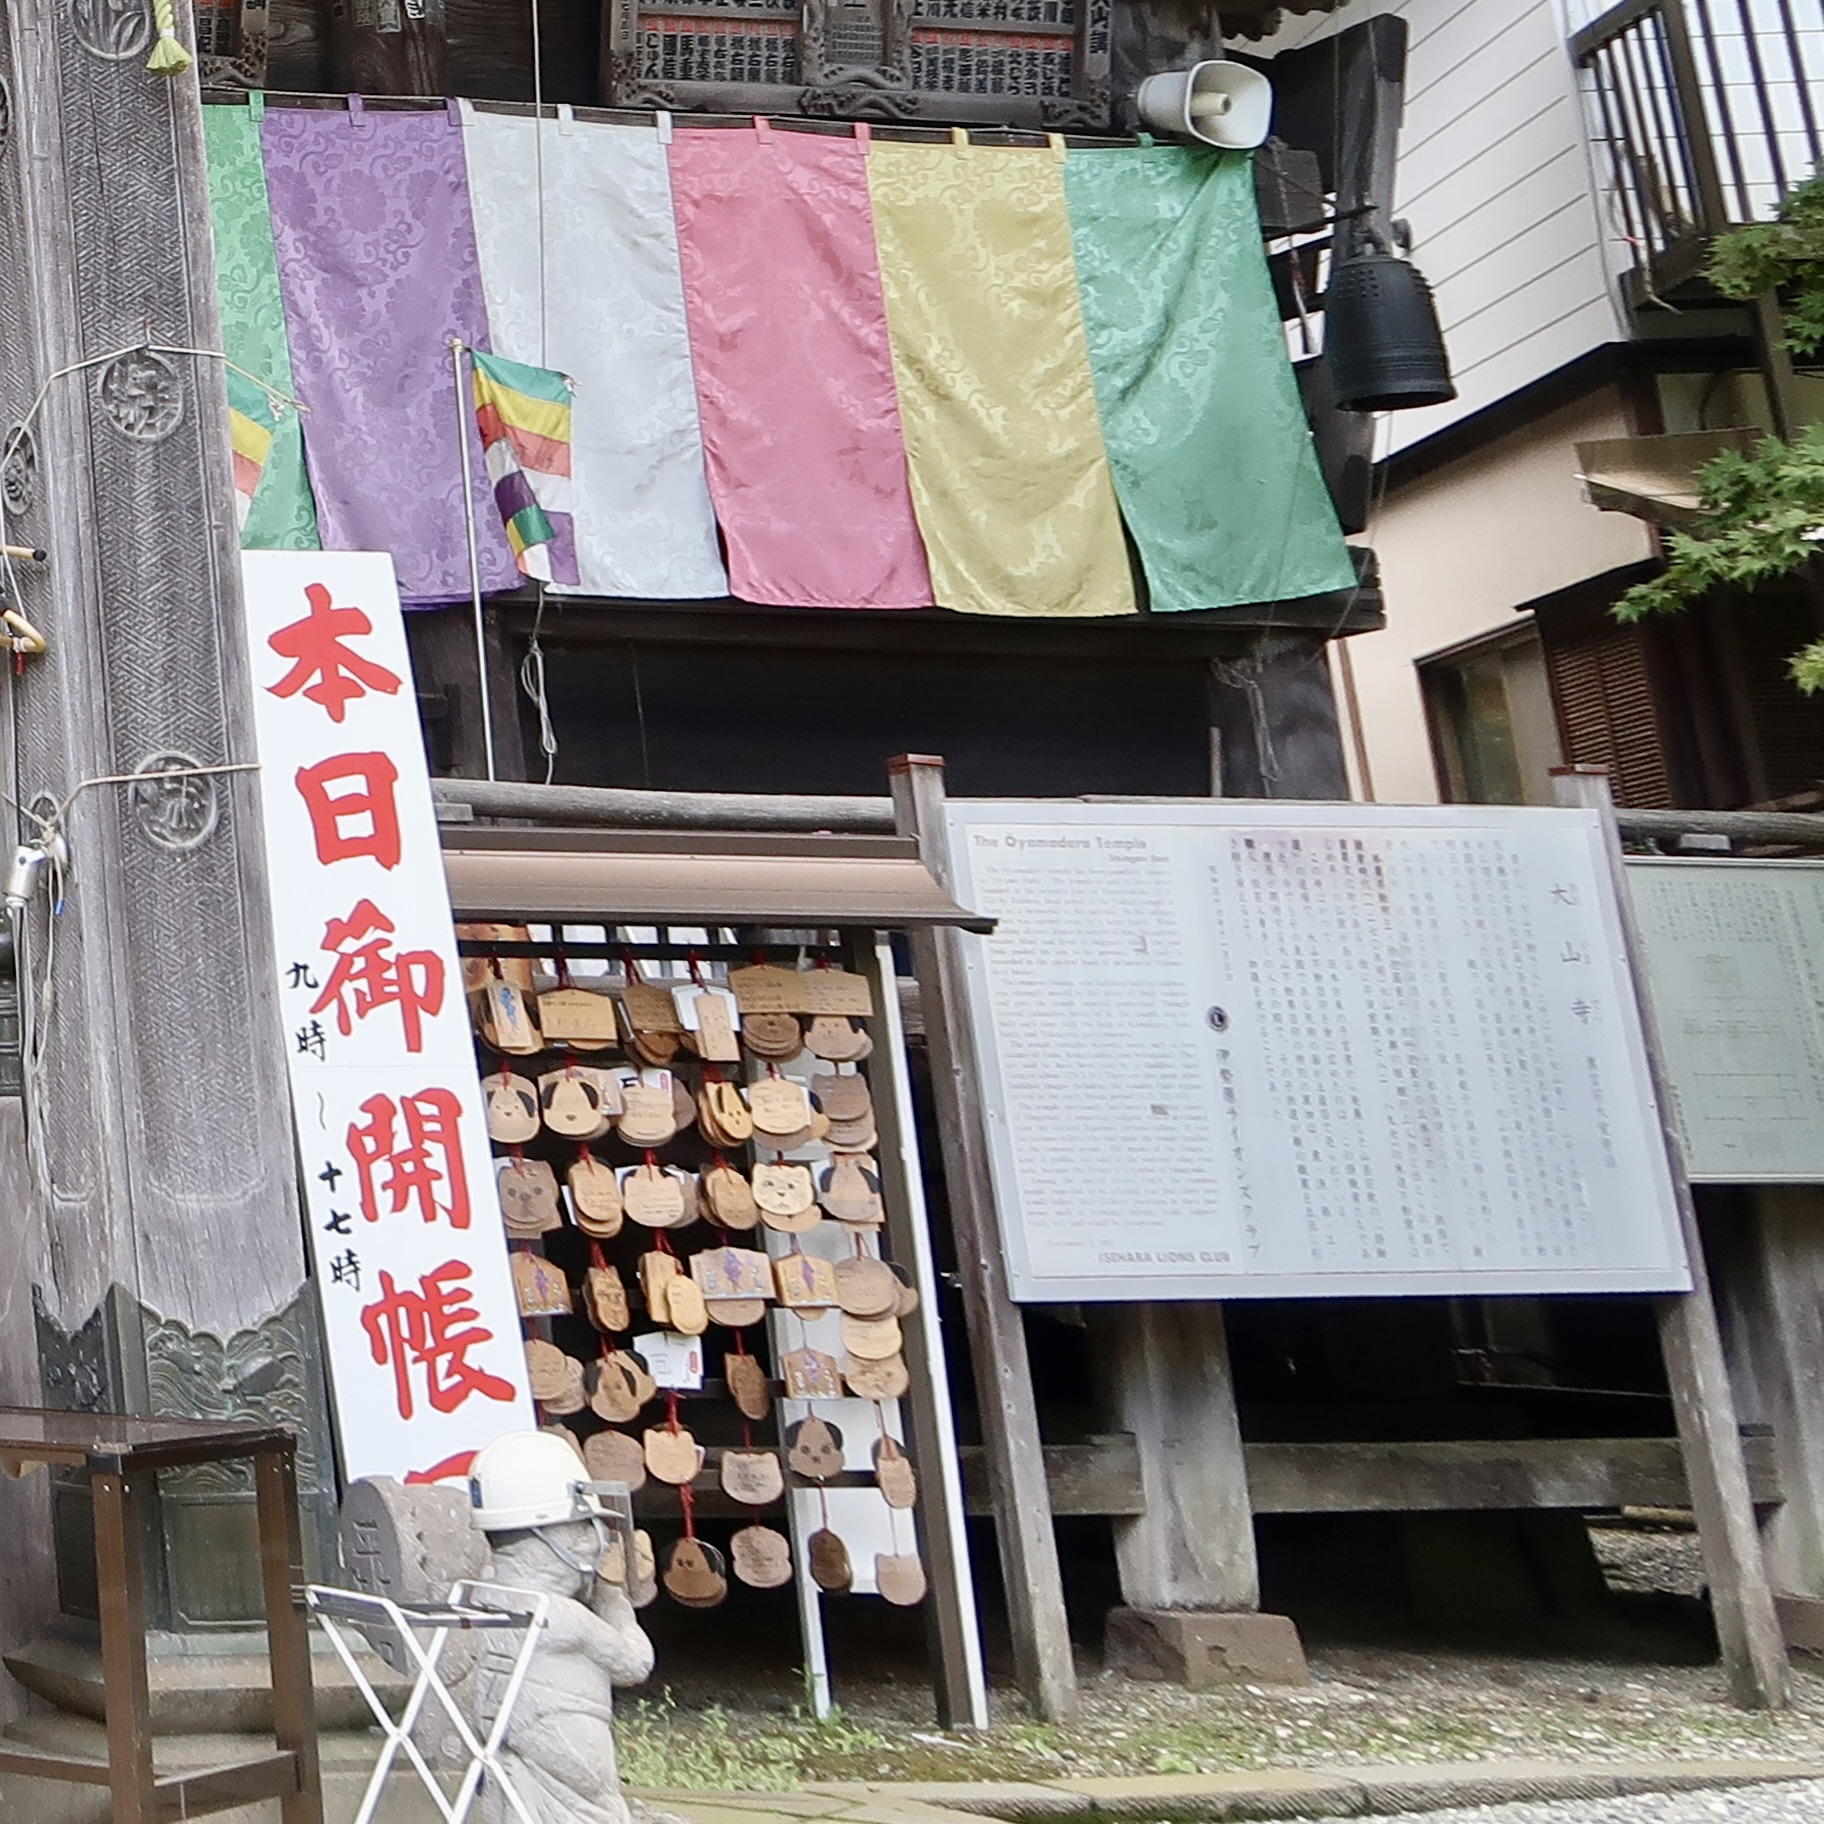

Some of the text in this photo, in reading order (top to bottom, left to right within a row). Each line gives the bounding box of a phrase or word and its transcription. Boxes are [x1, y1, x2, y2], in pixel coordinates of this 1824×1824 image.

[265, 581, 517, 1484] 本日御開帳
[973, 834, 999, 848] The
[1095, 836, 1147, 851] Temple
